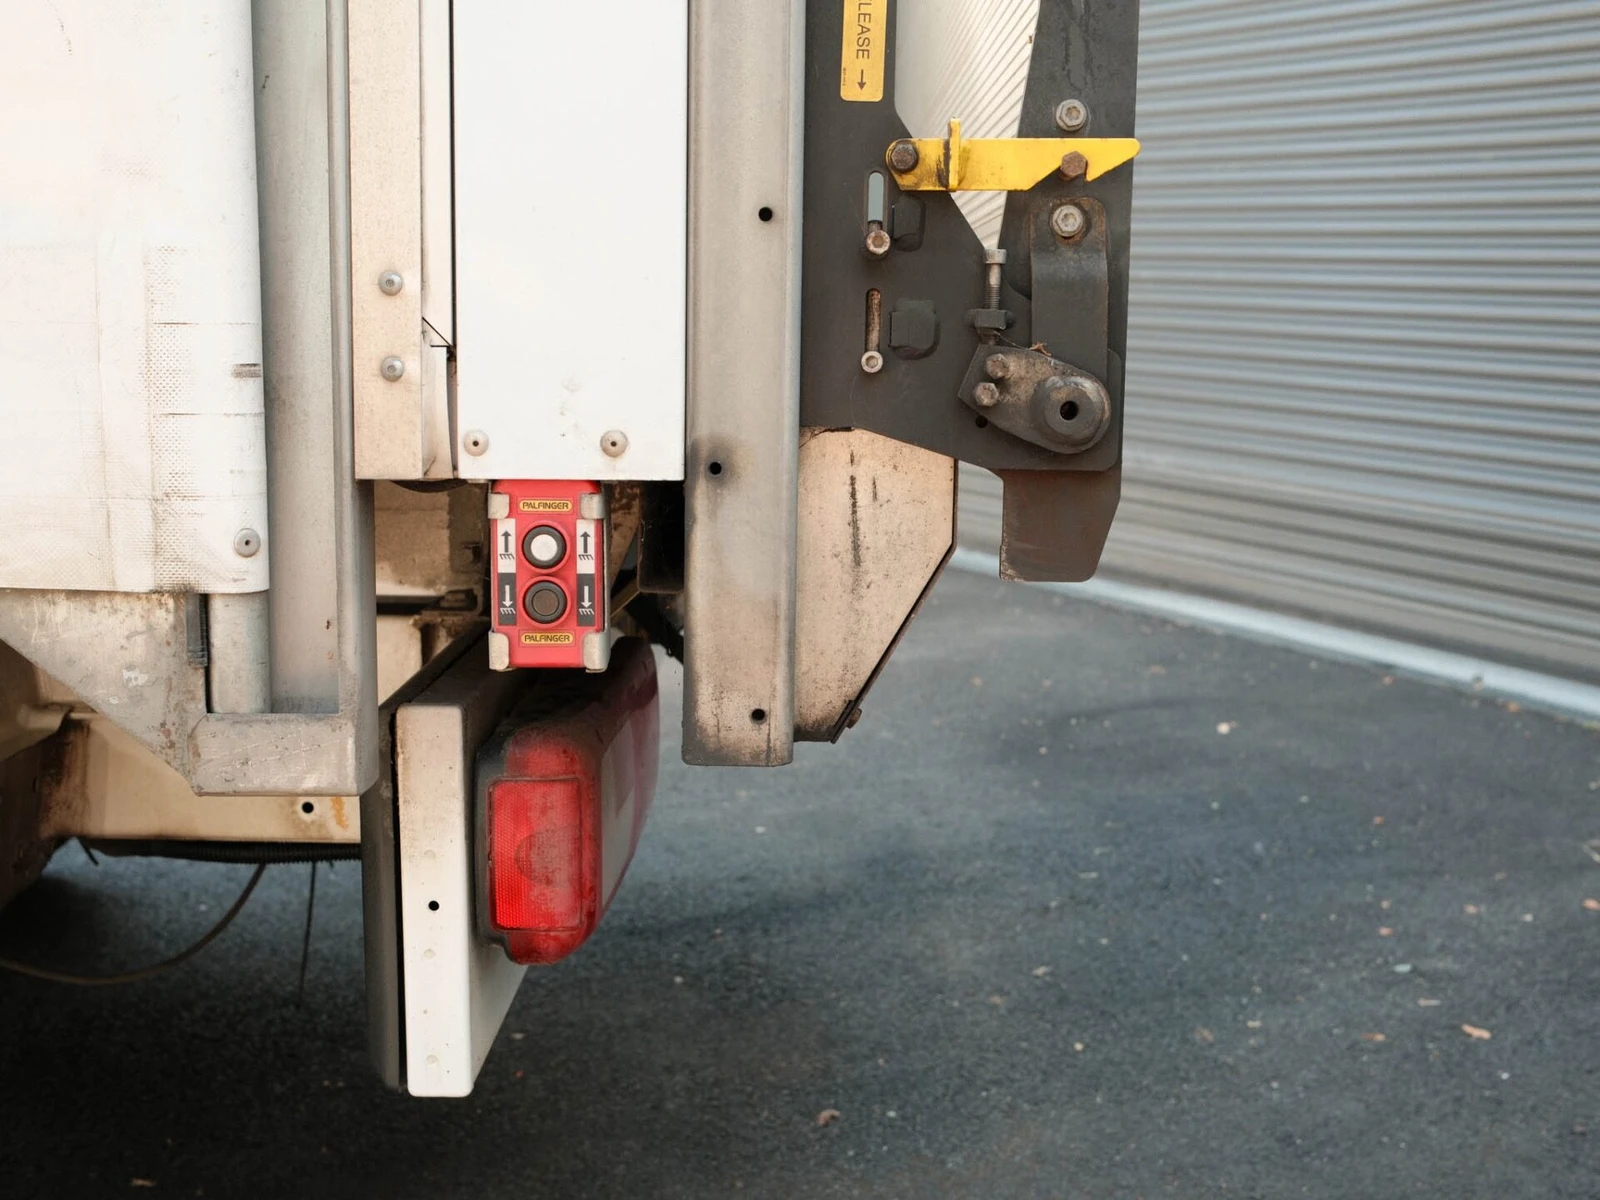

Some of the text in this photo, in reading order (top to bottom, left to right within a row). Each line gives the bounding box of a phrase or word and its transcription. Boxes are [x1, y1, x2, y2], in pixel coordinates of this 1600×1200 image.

[856, 0, 872, 59] LEASE
[522, 501, 569, 510] PALFINGER
[524, 634, 571, 643] PALFINGER
